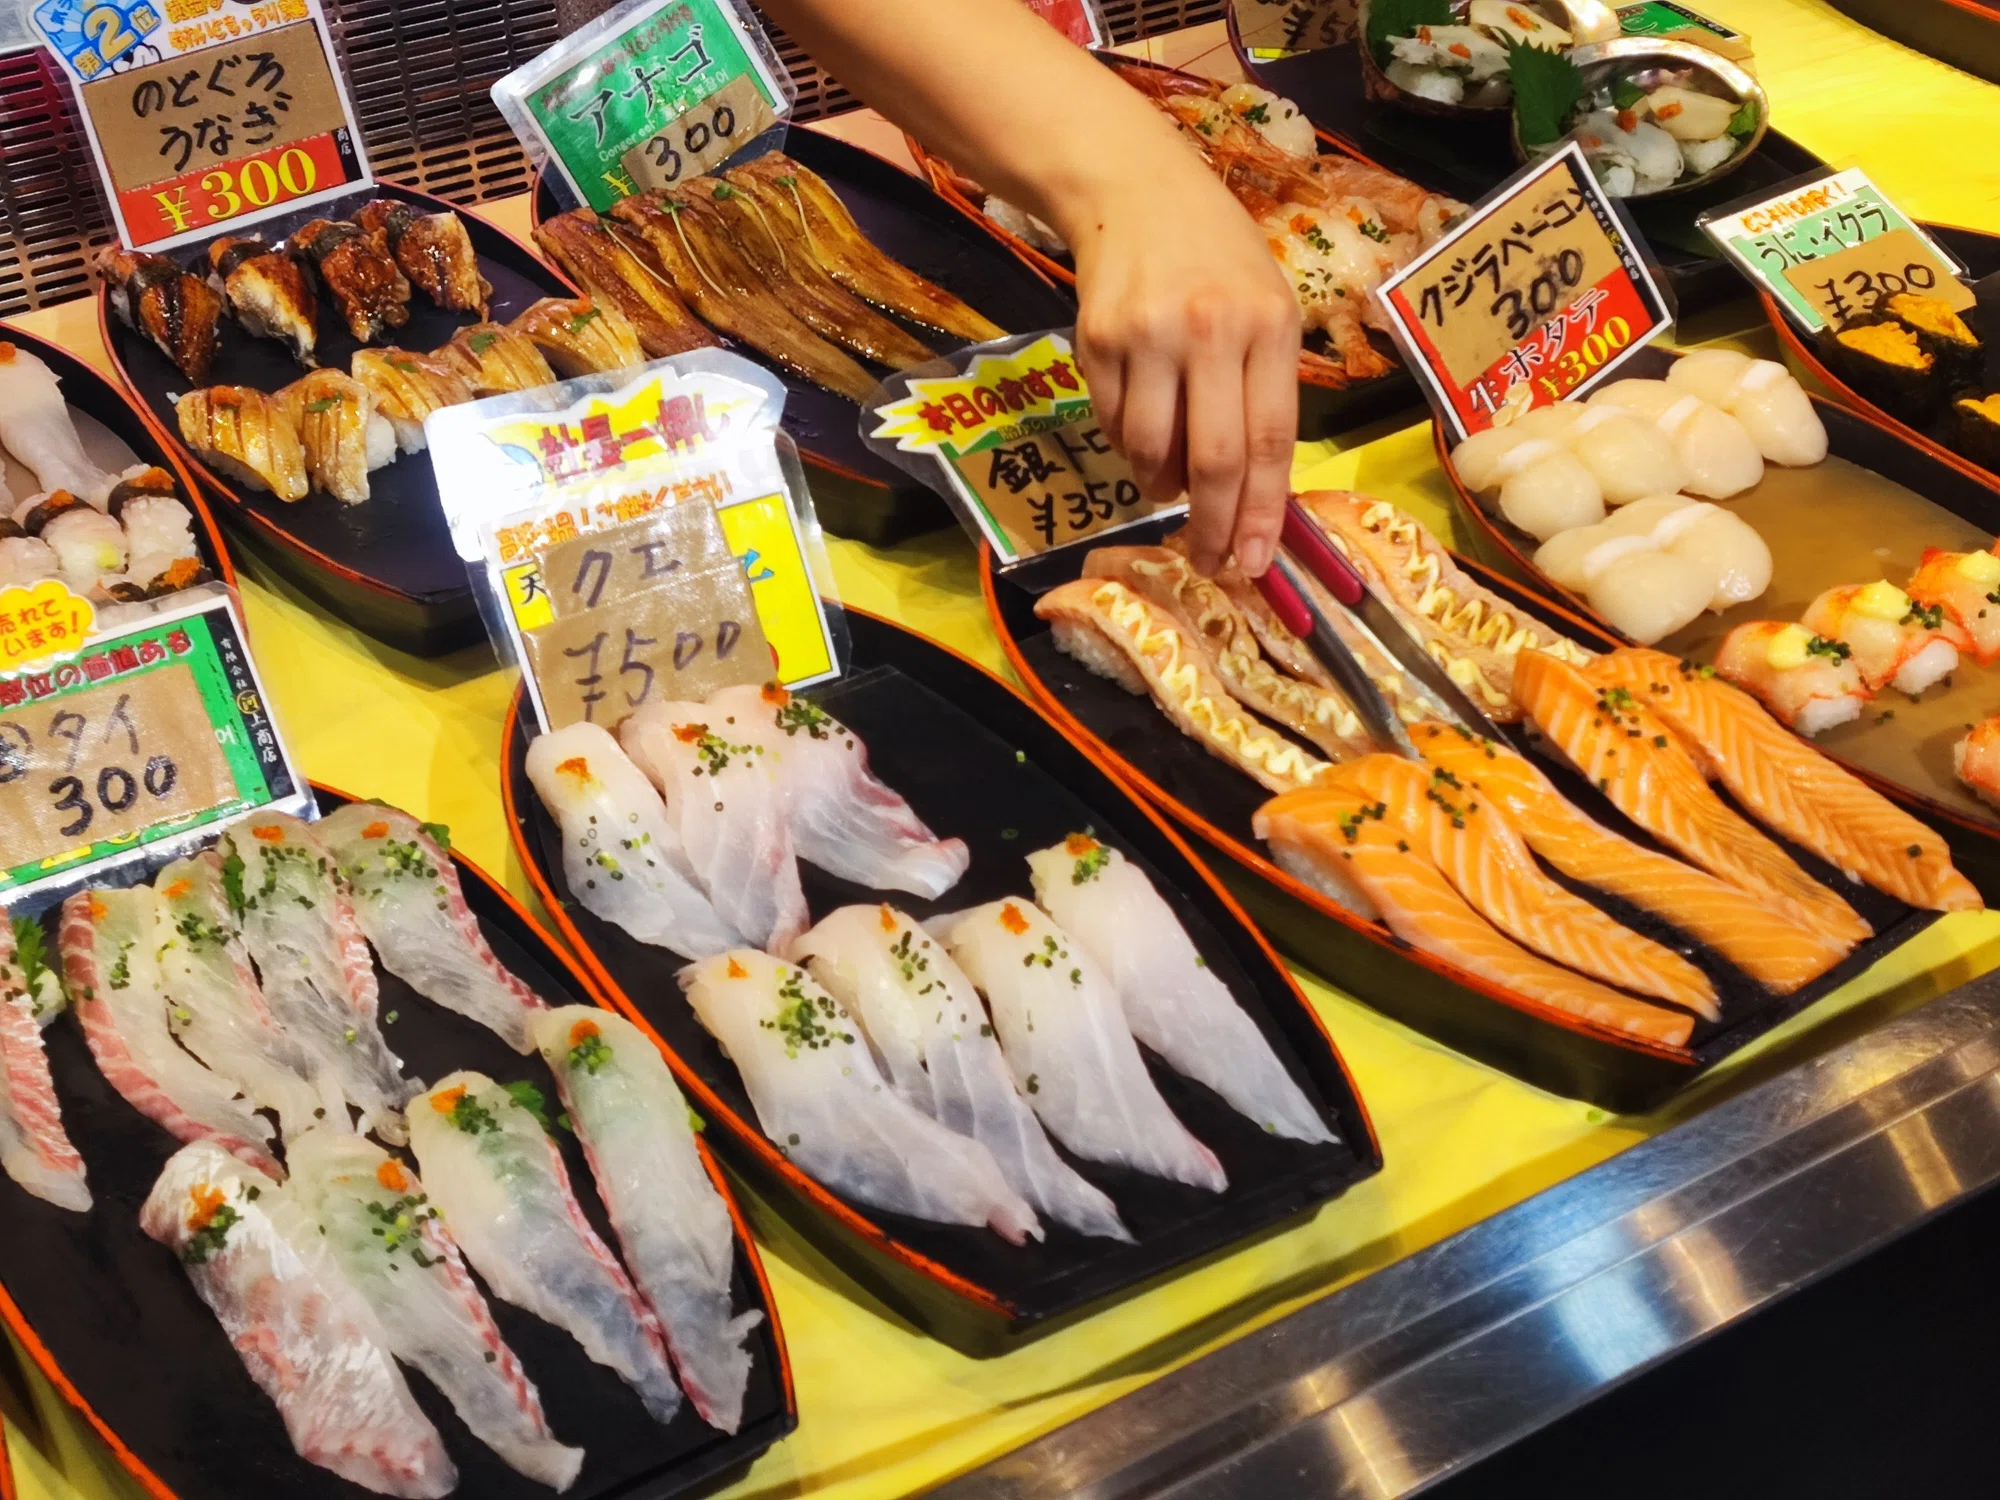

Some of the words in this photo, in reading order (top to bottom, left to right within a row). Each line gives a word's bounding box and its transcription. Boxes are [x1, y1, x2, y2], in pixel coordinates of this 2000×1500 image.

[133, 52, 285, 117] のどぐろ
[567, 23, 714, 148] アナゴ
[160, 91, 293, 172] うなぎ
[599, 133, 637, 162] Conger
[646, 106, 736, 182] 300
[153, 148, 316, 234] ¥300
[1420, 187, 1585, 327] クジラベーコン
[1490, 249, 1584, 340] 300
[1814, 263, 1936, 322] ¥300
[1470, 287, 1609, 423] 生ホタテ
[1538, 316, 1631, 398] ¥300
[537, 393, 731, 485] 社長一押し
[1026, 479, 1140, 546] ¥350
[572, 541, 683, 608] クエ
[4, 610, 79, 657] います!
[562, 620, 742, 723] ¥500
[48, 755, 178, 837] 300
